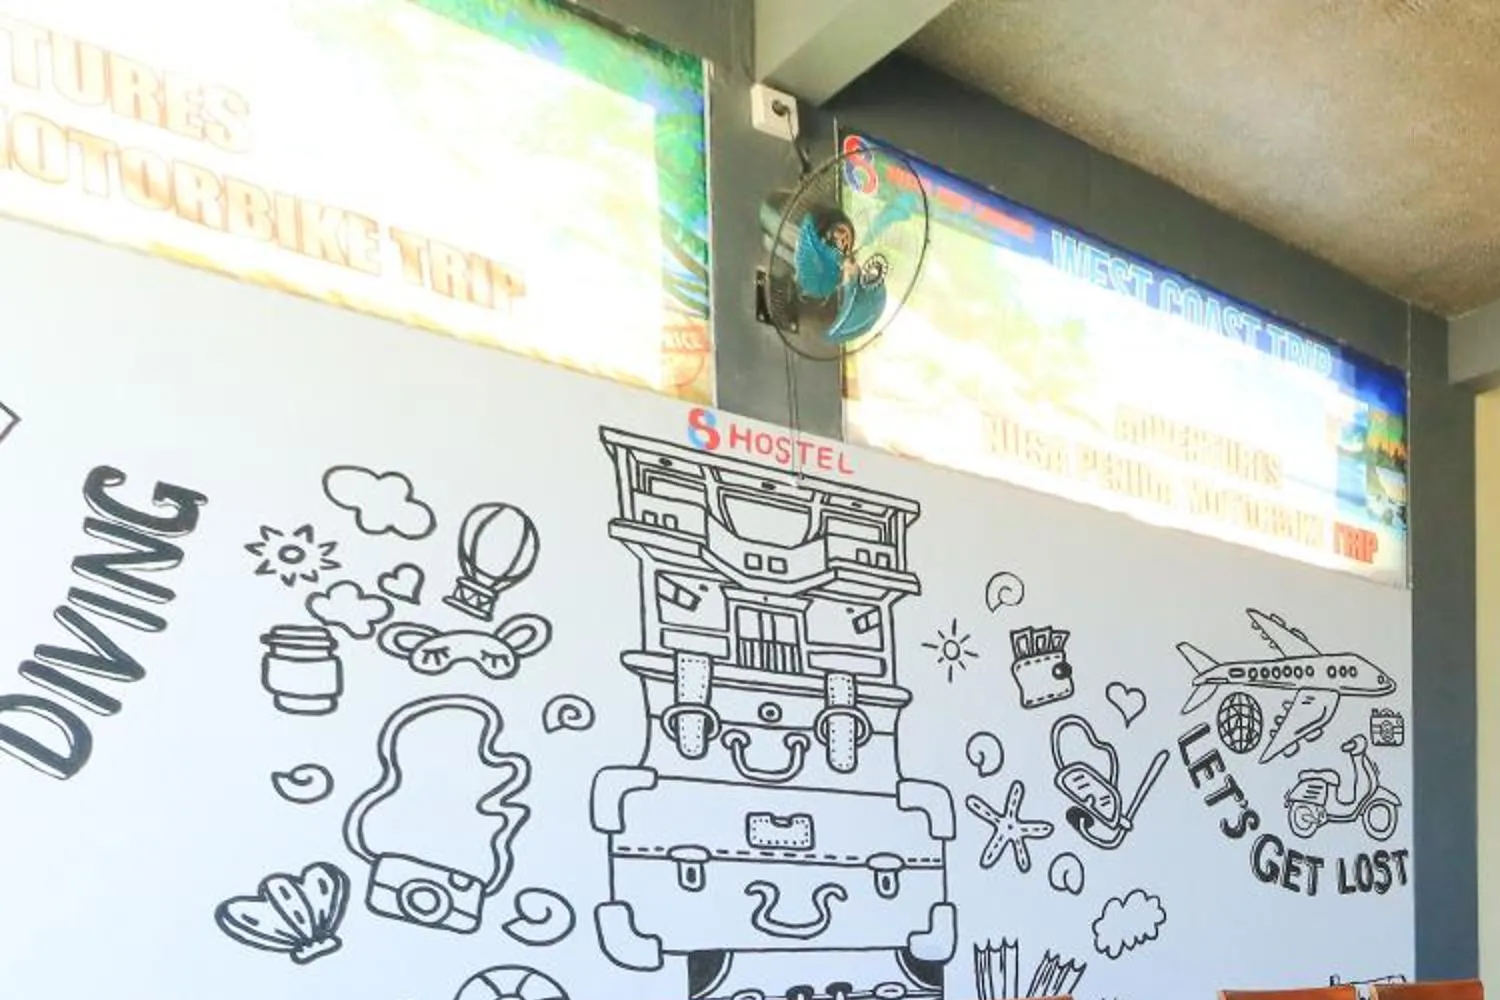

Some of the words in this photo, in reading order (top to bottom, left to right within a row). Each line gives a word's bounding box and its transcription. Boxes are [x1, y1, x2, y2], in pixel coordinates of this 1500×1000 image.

[0, 104, 382, 276] OTORBIKE
[389, 226, 526, 311] TRIP
[1051, 229, 1153, 299] WEST
[1159, 278, 1261, 346] COAST
[1266, 322, 1333, 378] TRIP
[729, 423, 855, 475] HOSTEL
[1333, 520, 1378, 564] TRIP
[0, 465, 208, 780] DIVING
[1251, 833, 1324, 896] GET
[1337, 849, 1408, 895] LOST
